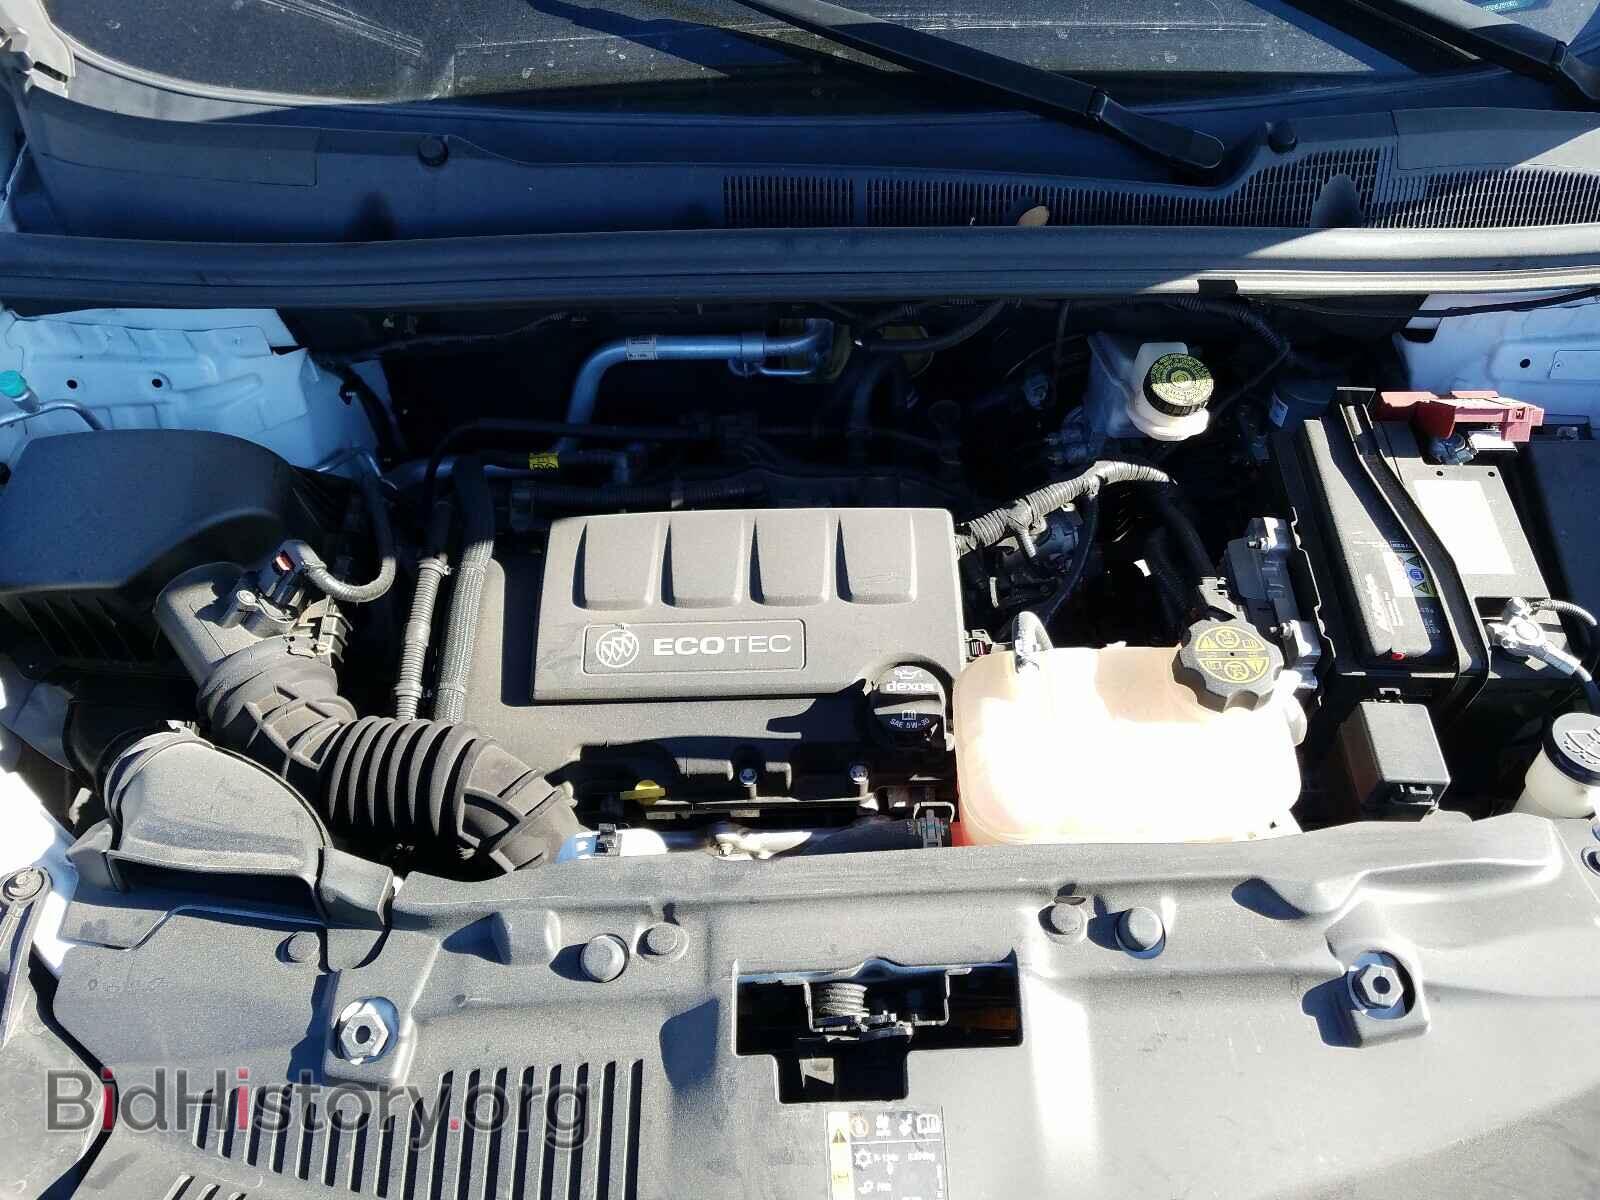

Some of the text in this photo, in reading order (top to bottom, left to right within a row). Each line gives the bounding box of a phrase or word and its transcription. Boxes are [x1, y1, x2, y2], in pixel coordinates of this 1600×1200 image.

[653, 634, 792, 656] ECOTEC
[886, 680, 934, 692] dexos
[889, 718, 904, 729] SAE
